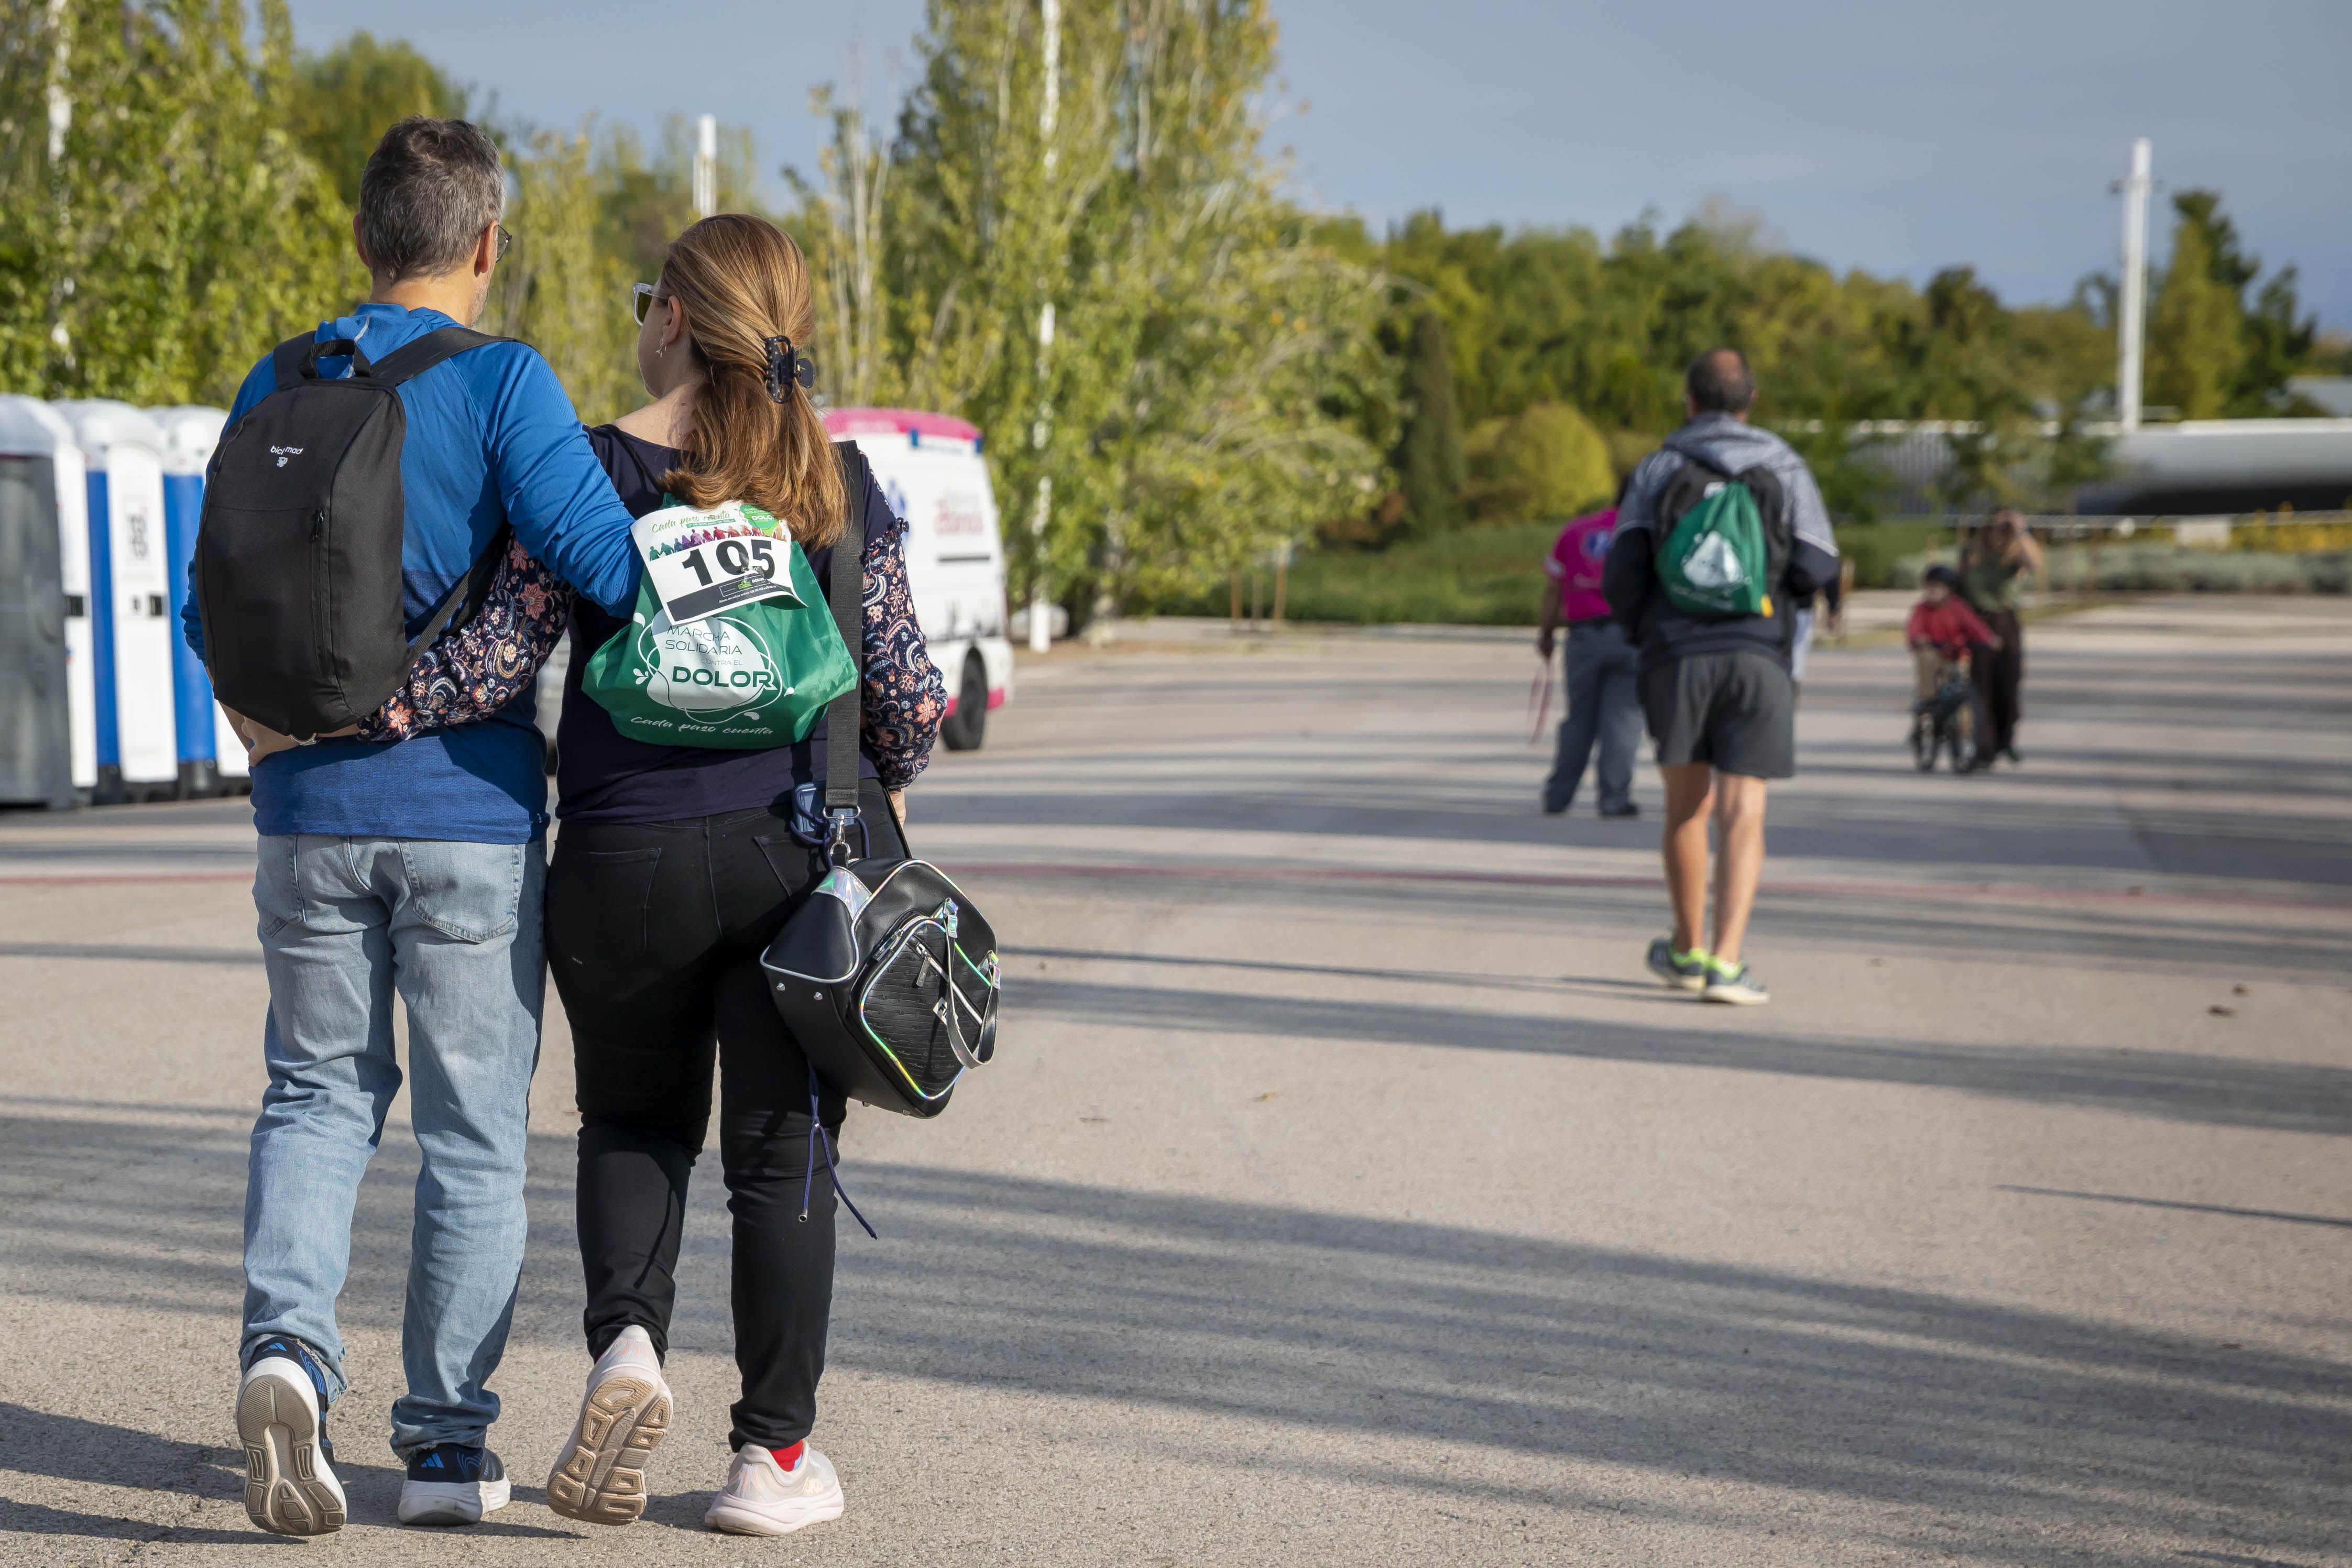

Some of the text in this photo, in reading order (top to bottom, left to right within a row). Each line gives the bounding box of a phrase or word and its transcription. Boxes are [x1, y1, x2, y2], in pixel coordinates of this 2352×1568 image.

[652, 519, 676, 533] Cada
[681, 516, 699, 527] paso
[682, 539, 775, 586] 105
[667, 625, 730, 642] MARCHA
[665, 640, 742, 655] SOLIDARIA
[672, 666, 778, 690] DOLOR
[631, 717, 773, 735] Cada paso cuenta
